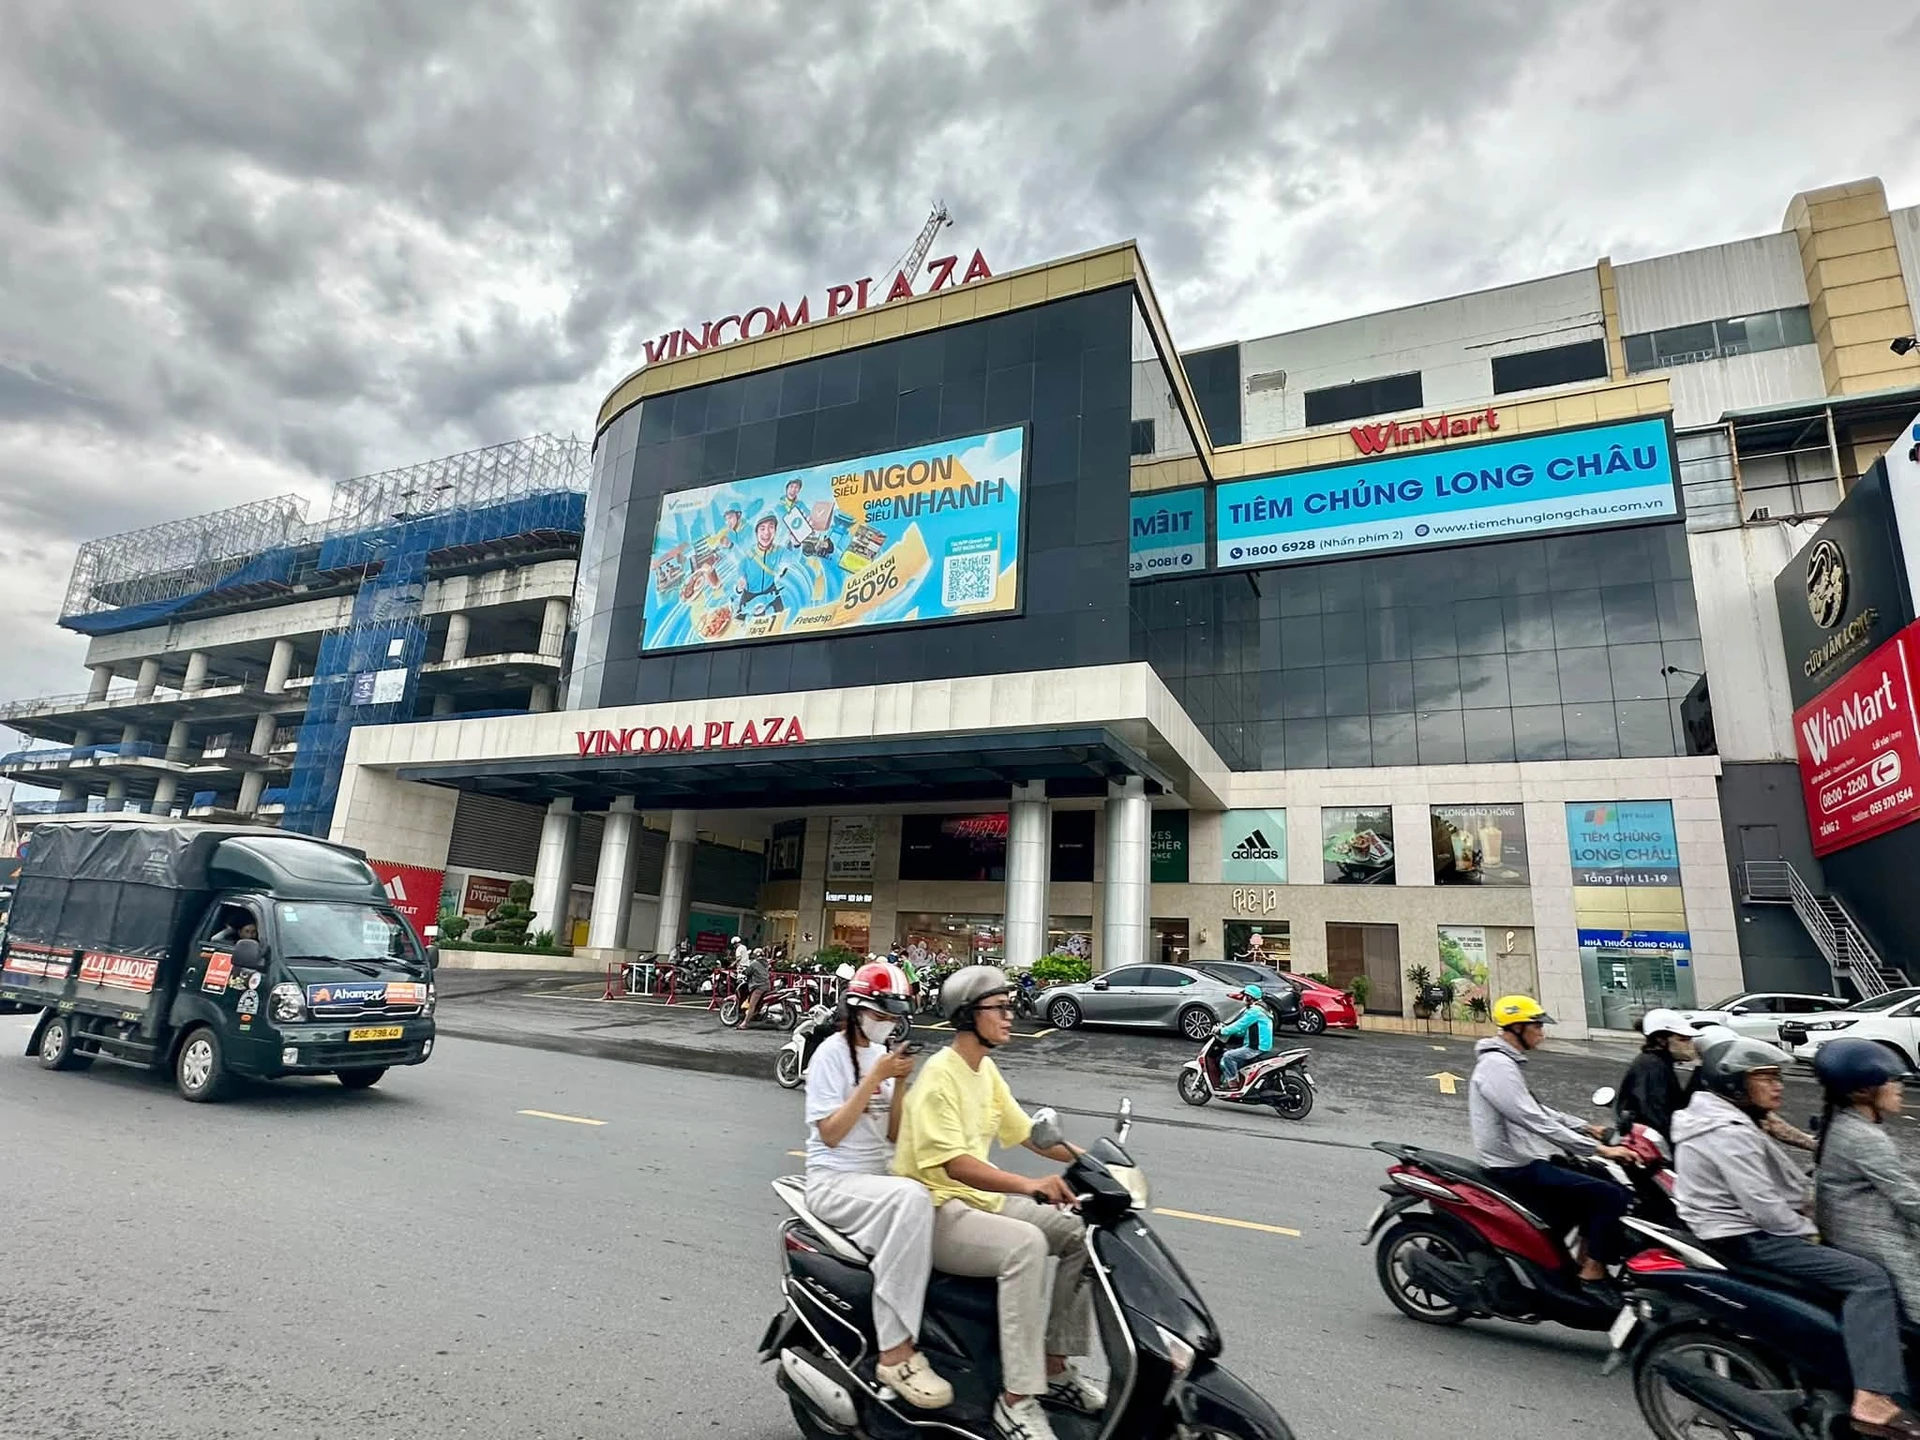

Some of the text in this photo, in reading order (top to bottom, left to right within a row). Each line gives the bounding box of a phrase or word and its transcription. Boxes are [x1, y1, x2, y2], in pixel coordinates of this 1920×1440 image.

[642, 249, 993, 363] VINCOM PLAZA
[1349, 407, 1500, 456] WinMart
[831, 454, 954, 494] DEAL NGON
[1229, 444, 1658, 524] TIÊM CHỦNG LONG CHÂU
[833, 484, 859, 498] SIÊU
[863, 477, 1005, 519] GIAO NHANH
[864, 508, 891, 523] SIÊU
[1433, 499, 1664, 535] www.tiemchunglongchau.com.vn
[1246, 544, 1278, 557] 1800
[1281, 540, 1316, 553] 6928
[1358, 531, 1389, 546] phím
[1391, 530, 1403, 541] 2)
[844, 566, 898, 610] 50%
[793, 612, 832, 626] Freeship
[1801, 671, 1897, 766] WinMart
[576, 716, 806, 757] VINCOM PLAZA
[1822, 786, 1843, 808] 08:00
[1847, 774, 1868, 796] 22:00
[1870, 800, 1883, 815] 055
[1231, 848, 1279, 860] adidas
[1575, 845, 1673, 861] LONG CHÂU
[1638, 873, 1668, 883] L1-19
[1634, 941, 1658, 949] LONG
[90, 955, 156, 980] LALAMOVE
